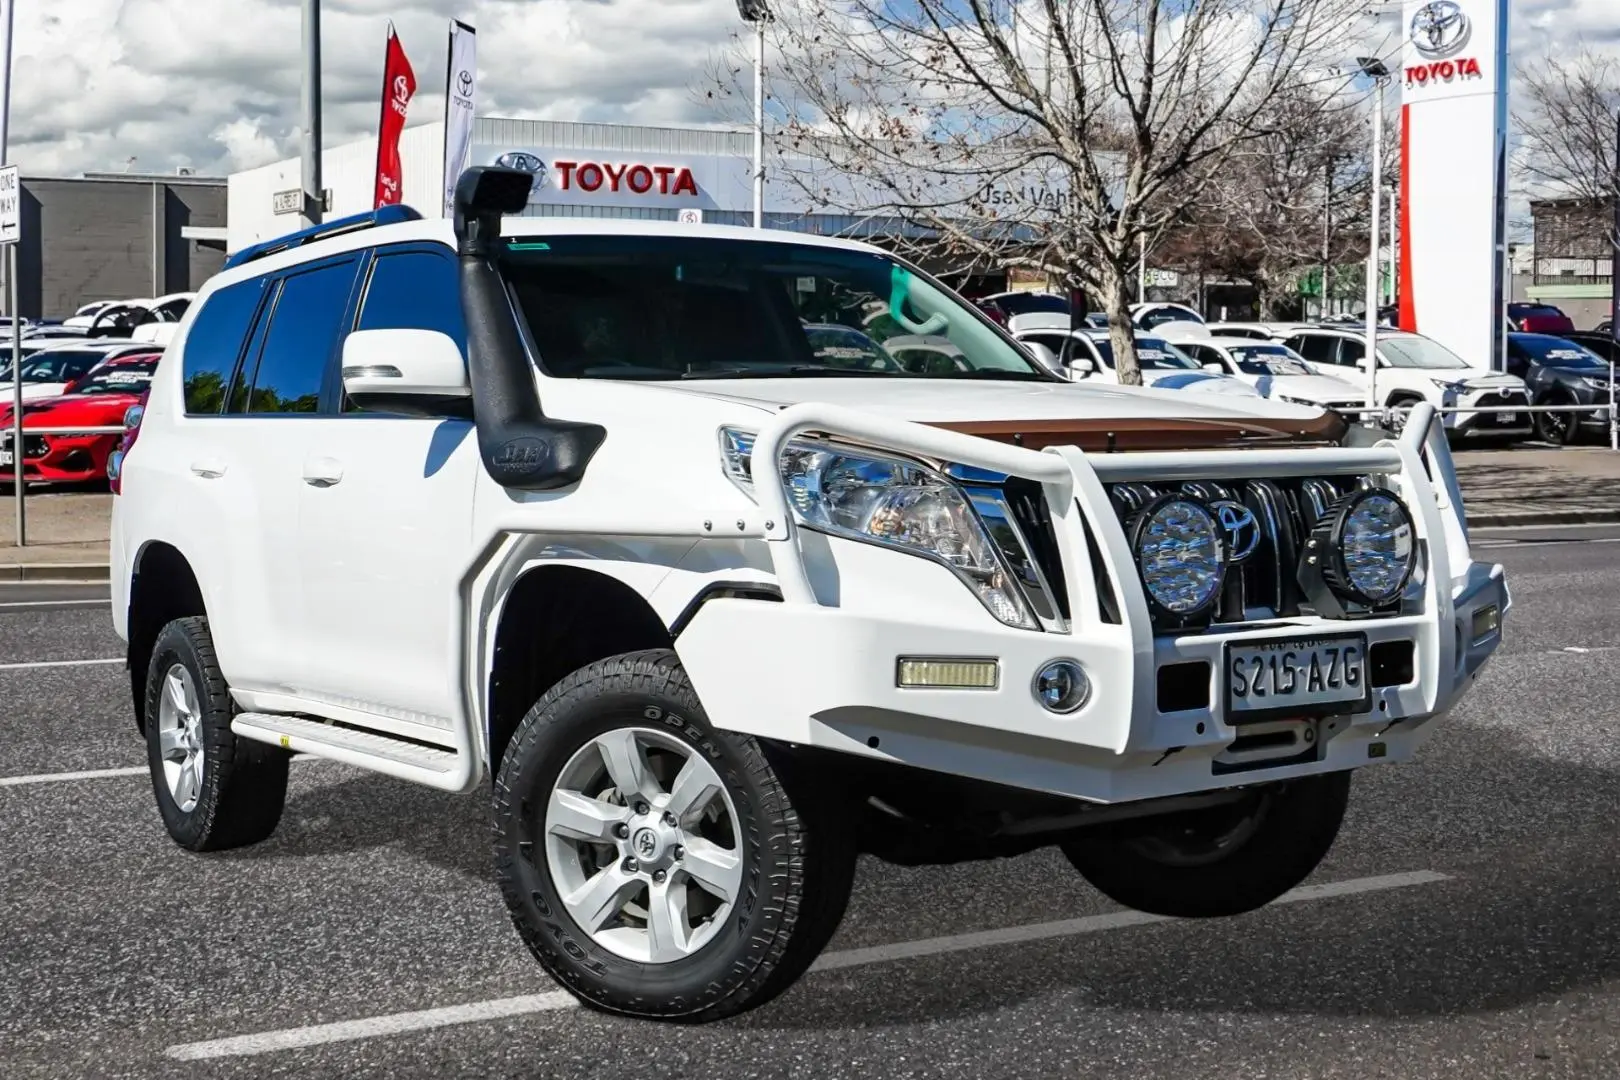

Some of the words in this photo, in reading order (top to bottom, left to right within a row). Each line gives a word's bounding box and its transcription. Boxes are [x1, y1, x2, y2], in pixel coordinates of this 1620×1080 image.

[1404, 58, 1480, 83] TOYOTA
[1, 173, 15, 191] ONE
[554, 161, 698, 196] TOYOTA
[1, 196, 17, 212] WAY
[644, 704, 722, 759] OPEN
